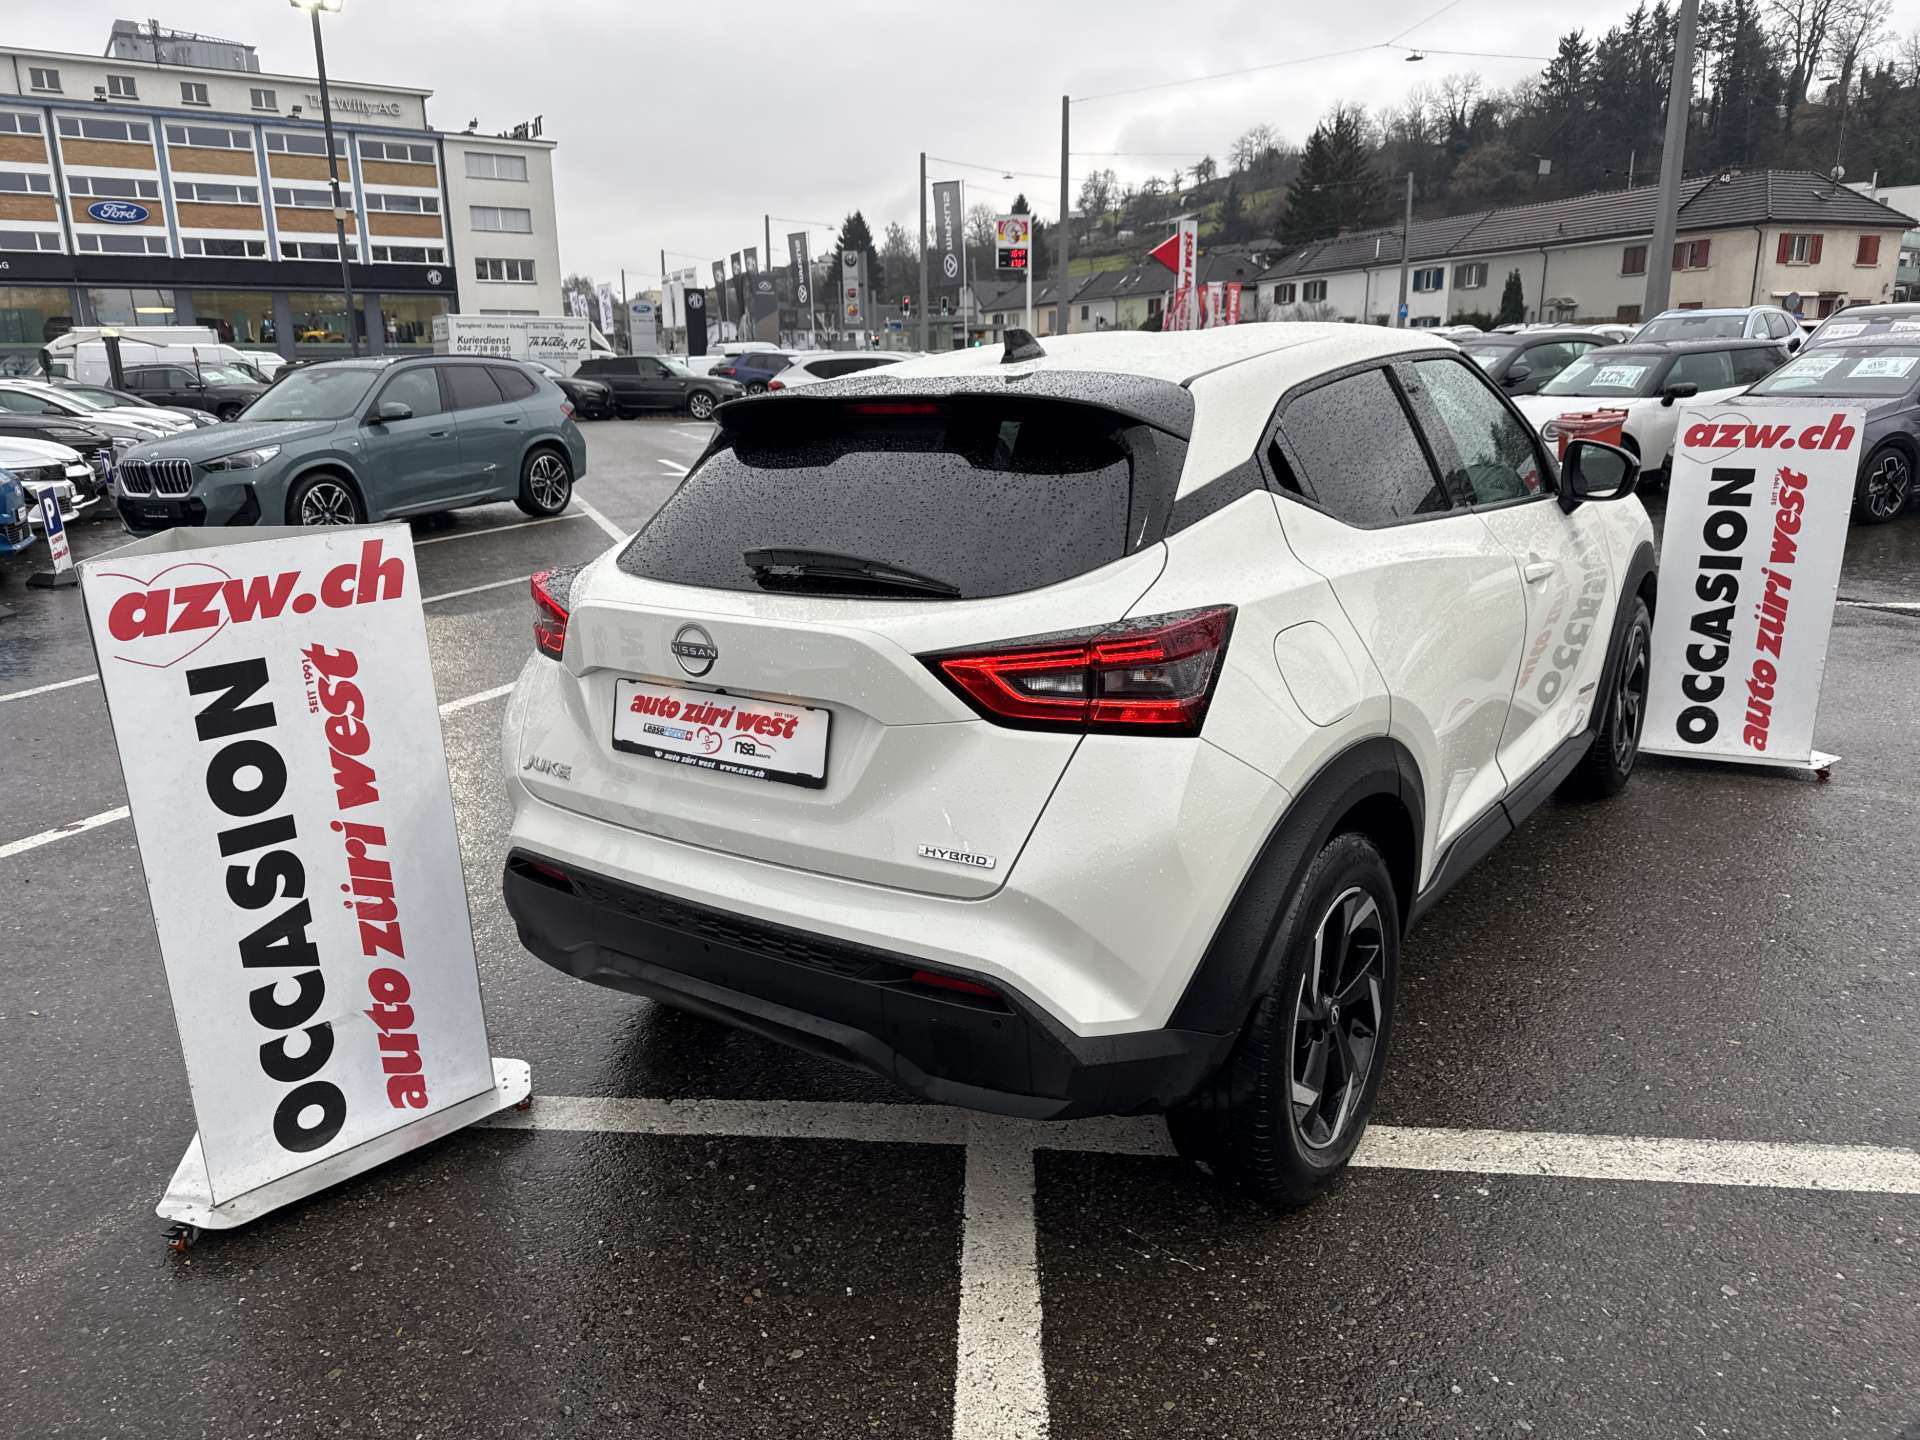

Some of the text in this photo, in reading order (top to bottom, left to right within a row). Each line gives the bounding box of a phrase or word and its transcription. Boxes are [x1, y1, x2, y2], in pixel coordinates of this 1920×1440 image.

[335, 96, 374, 117] Willy
[378, 102, 401, 116] AG
[101, 203, 137, 219] Ford
[688, 294, 703, 309] MG
[457, 335, 510, 345] Kurierdienst
[1684, 414, 1855, 450] azw.ch
[1771, 490, 1779, 505] SEIT
[44, 497, 54, 529] P
[108, 539, 405, 641] azw.ch
[1676, 468, 1756, 744] OCCASION
[1743, 466, 1808, 751] auto züri west
[672, 644, 716, 658] NISSAN
[302, 659, 319, 714] SEIT 1991
[630, 694, 799, 739] auto züri west
[664, 752, 681, 762] auto
[734, 740, 756, 756] nsa
[522, 755, 572, 780] JUKE
[924, 846, 988, 866] HYBRID
[300, 643, 428, 1109] auto züri west
[185, 656, 347, 1152] OCCASION
